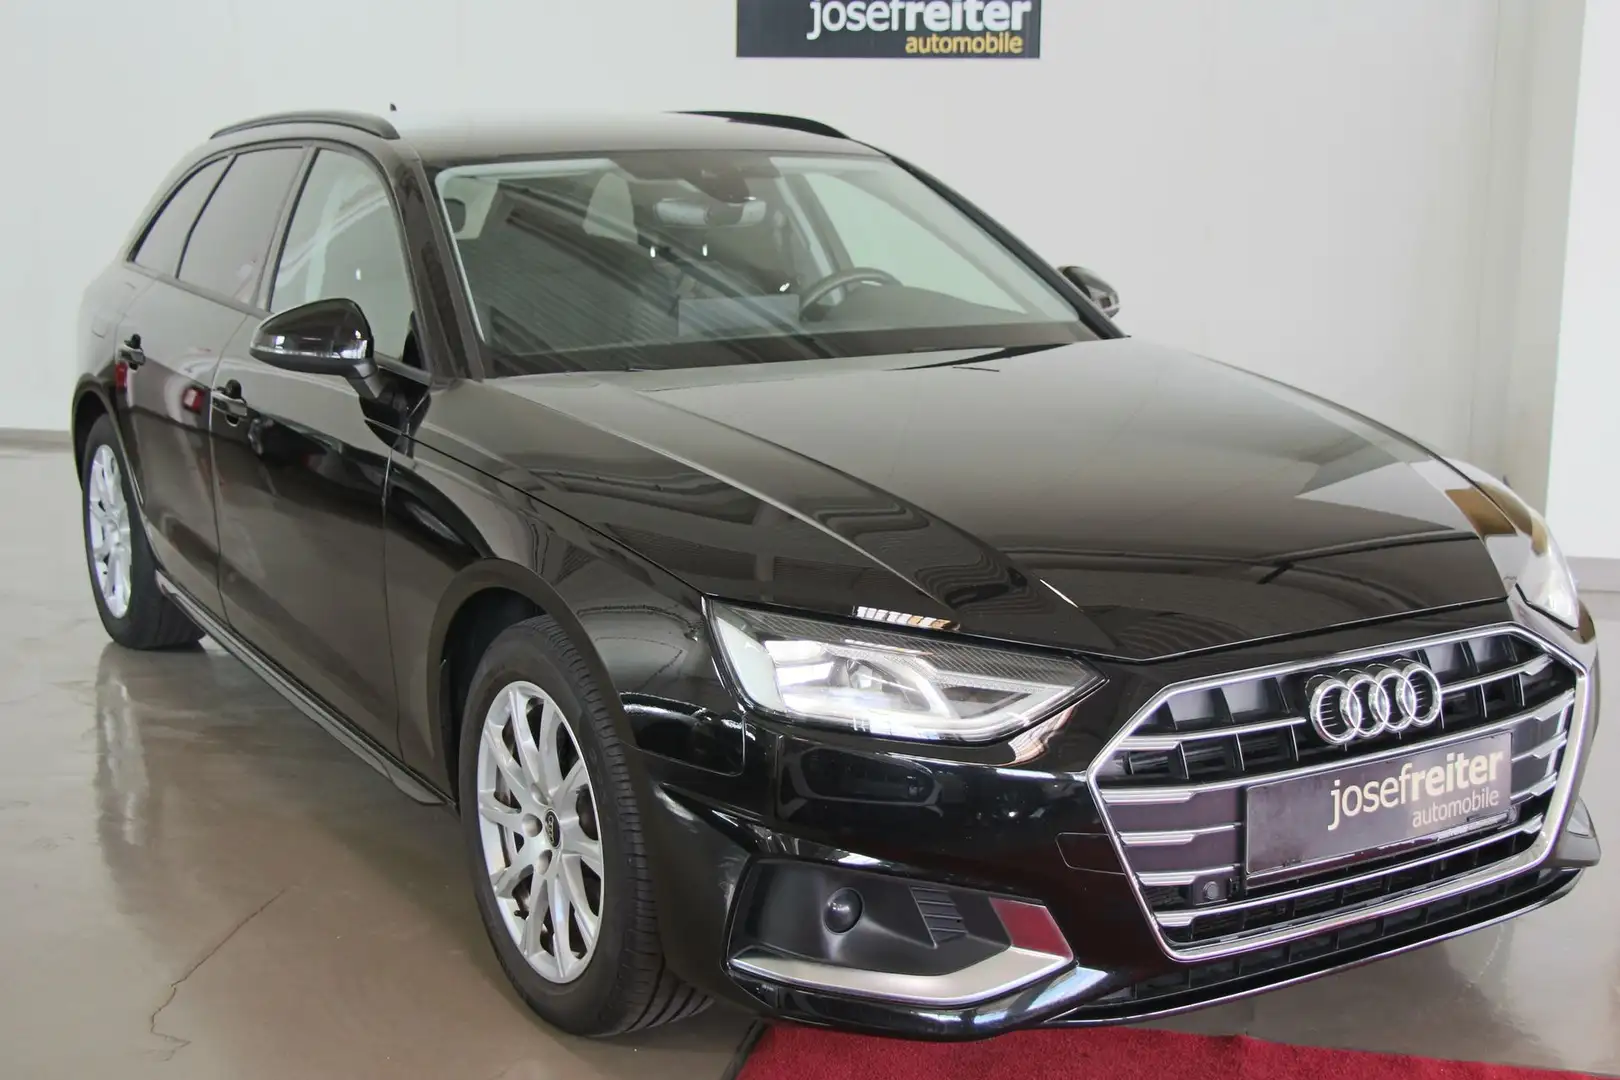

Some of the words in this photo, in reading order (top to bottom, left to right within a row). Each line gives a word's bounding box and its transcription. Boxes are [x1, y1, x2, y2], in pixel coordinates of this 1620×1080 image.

[807, 0, 1031, 40] josefreiter
[905, 33, 1023, 54] automobile
[1327, 751, 1504, 831] josefreiter
[1412, 788, 1499, 828] automobile
